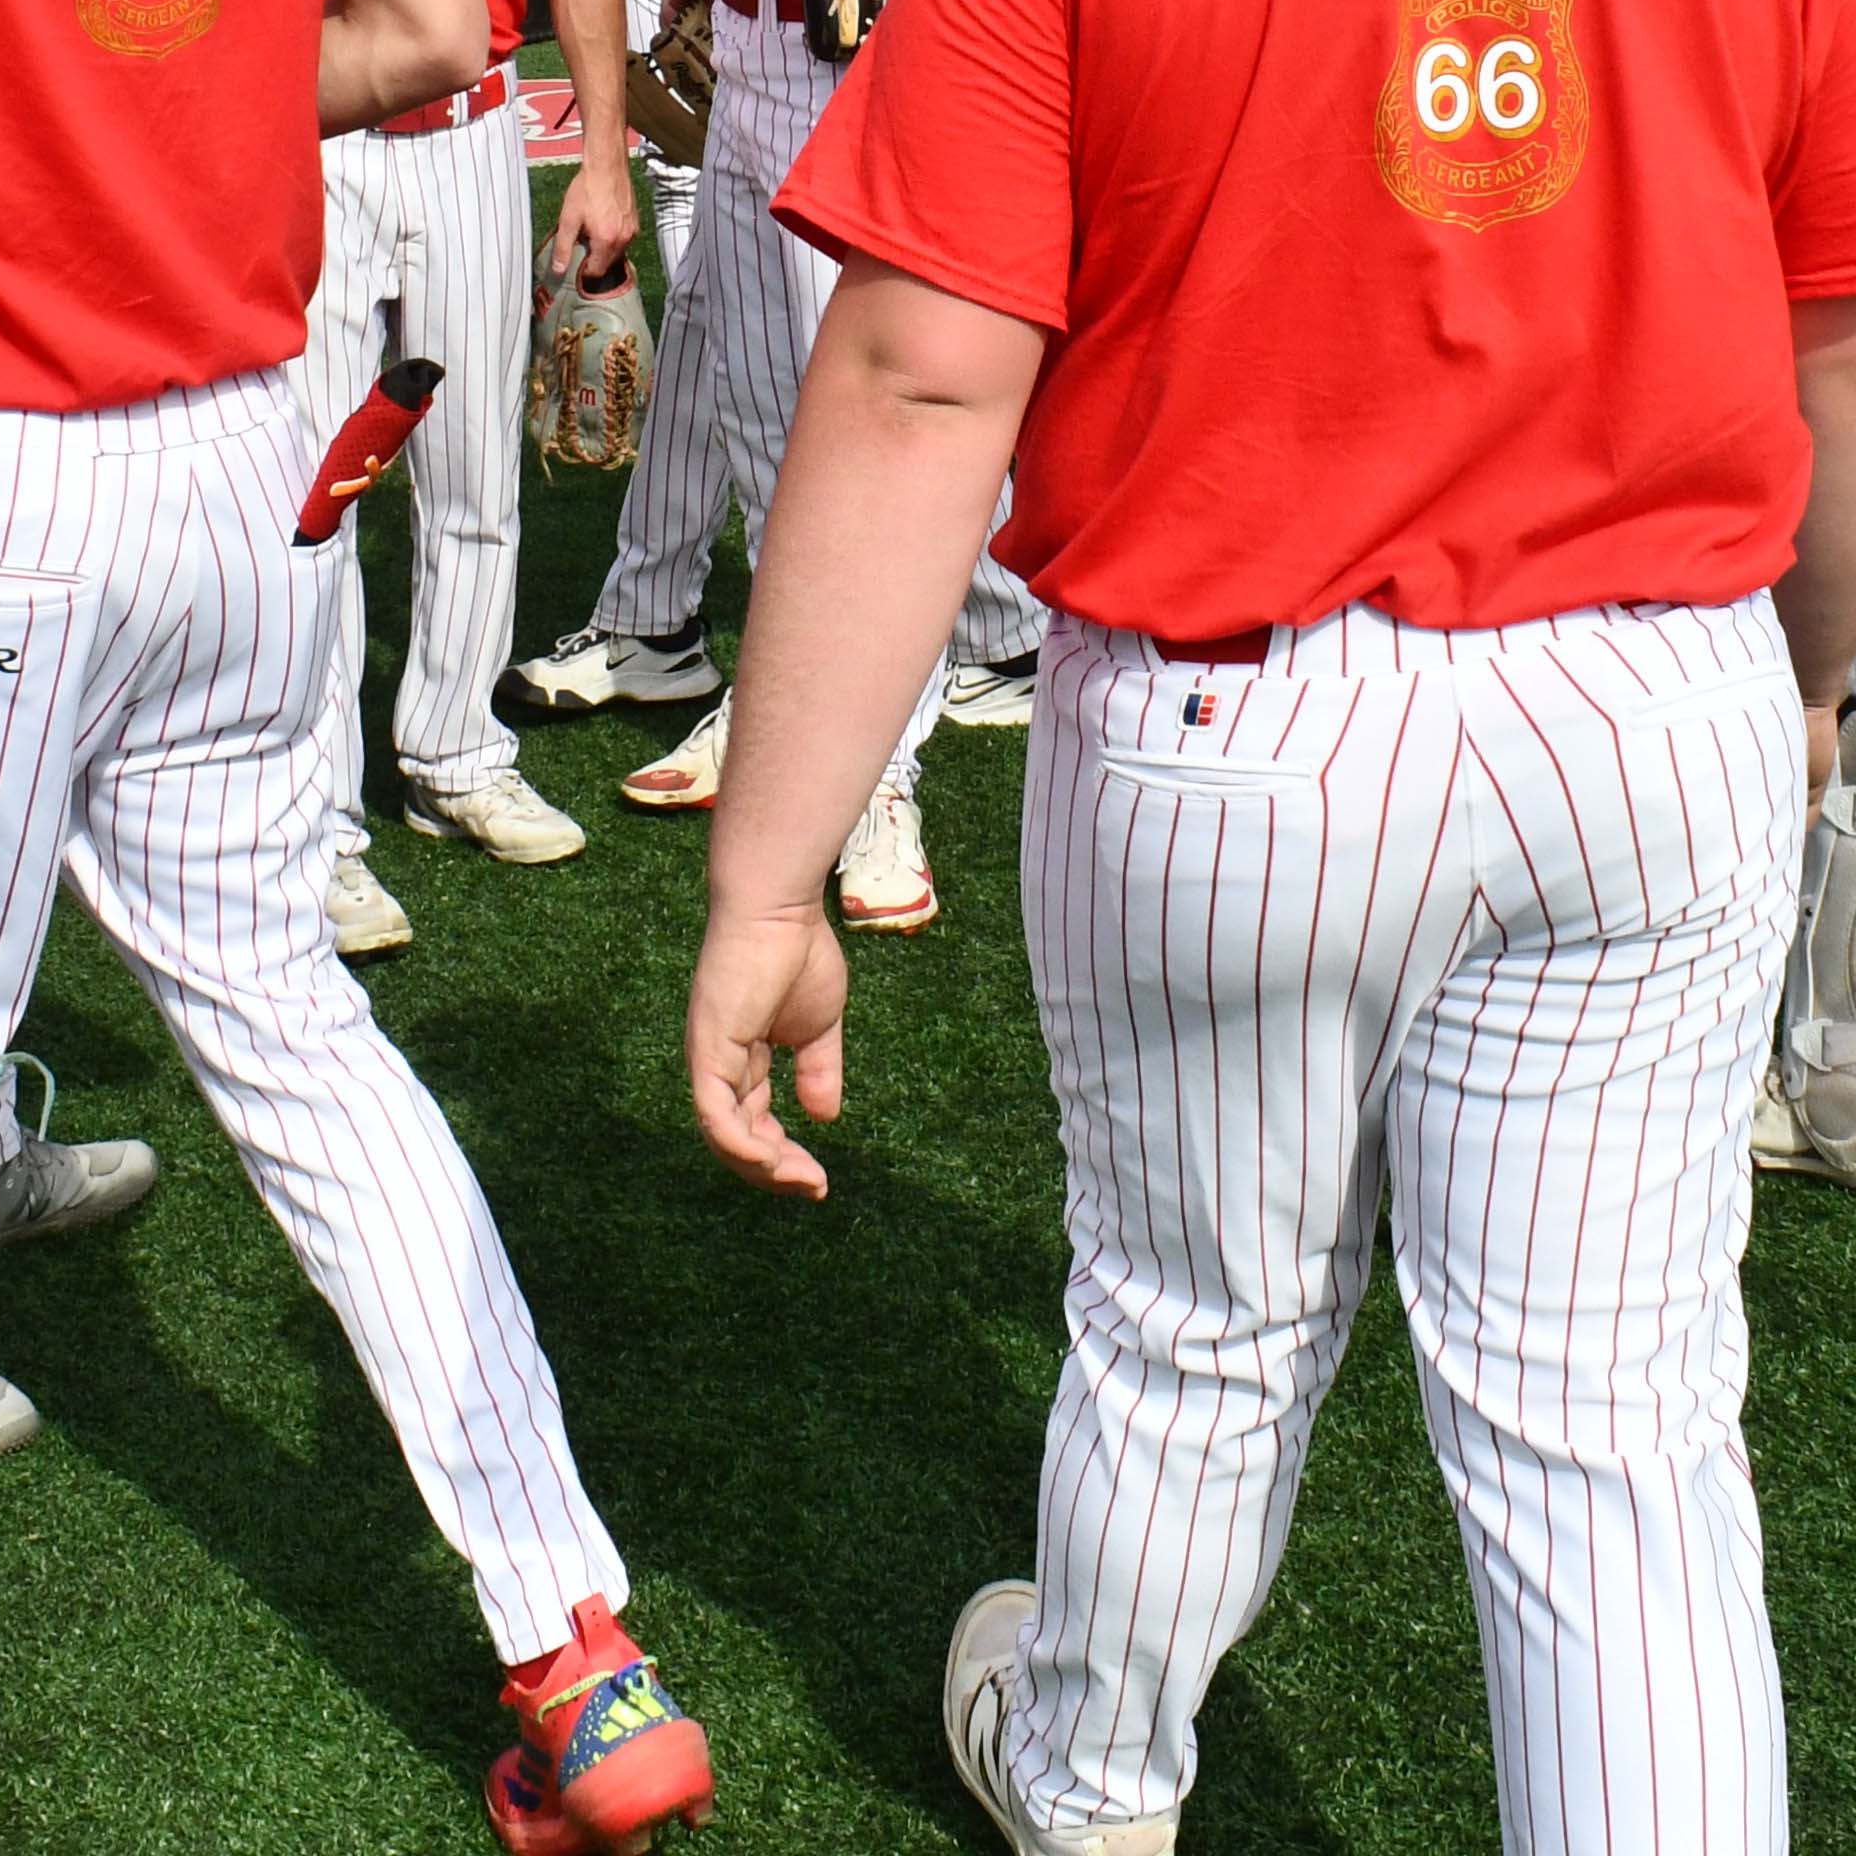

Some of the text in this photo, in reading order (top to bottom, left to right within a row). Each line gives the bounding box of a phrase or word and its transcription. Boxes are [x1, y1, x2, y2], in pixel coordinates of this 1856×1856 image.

[1432, 0, 1520, 26] POLICE
[1414, 39, 1542, 135] 66
[1426, 151, 1537, 180] SERGEANT
